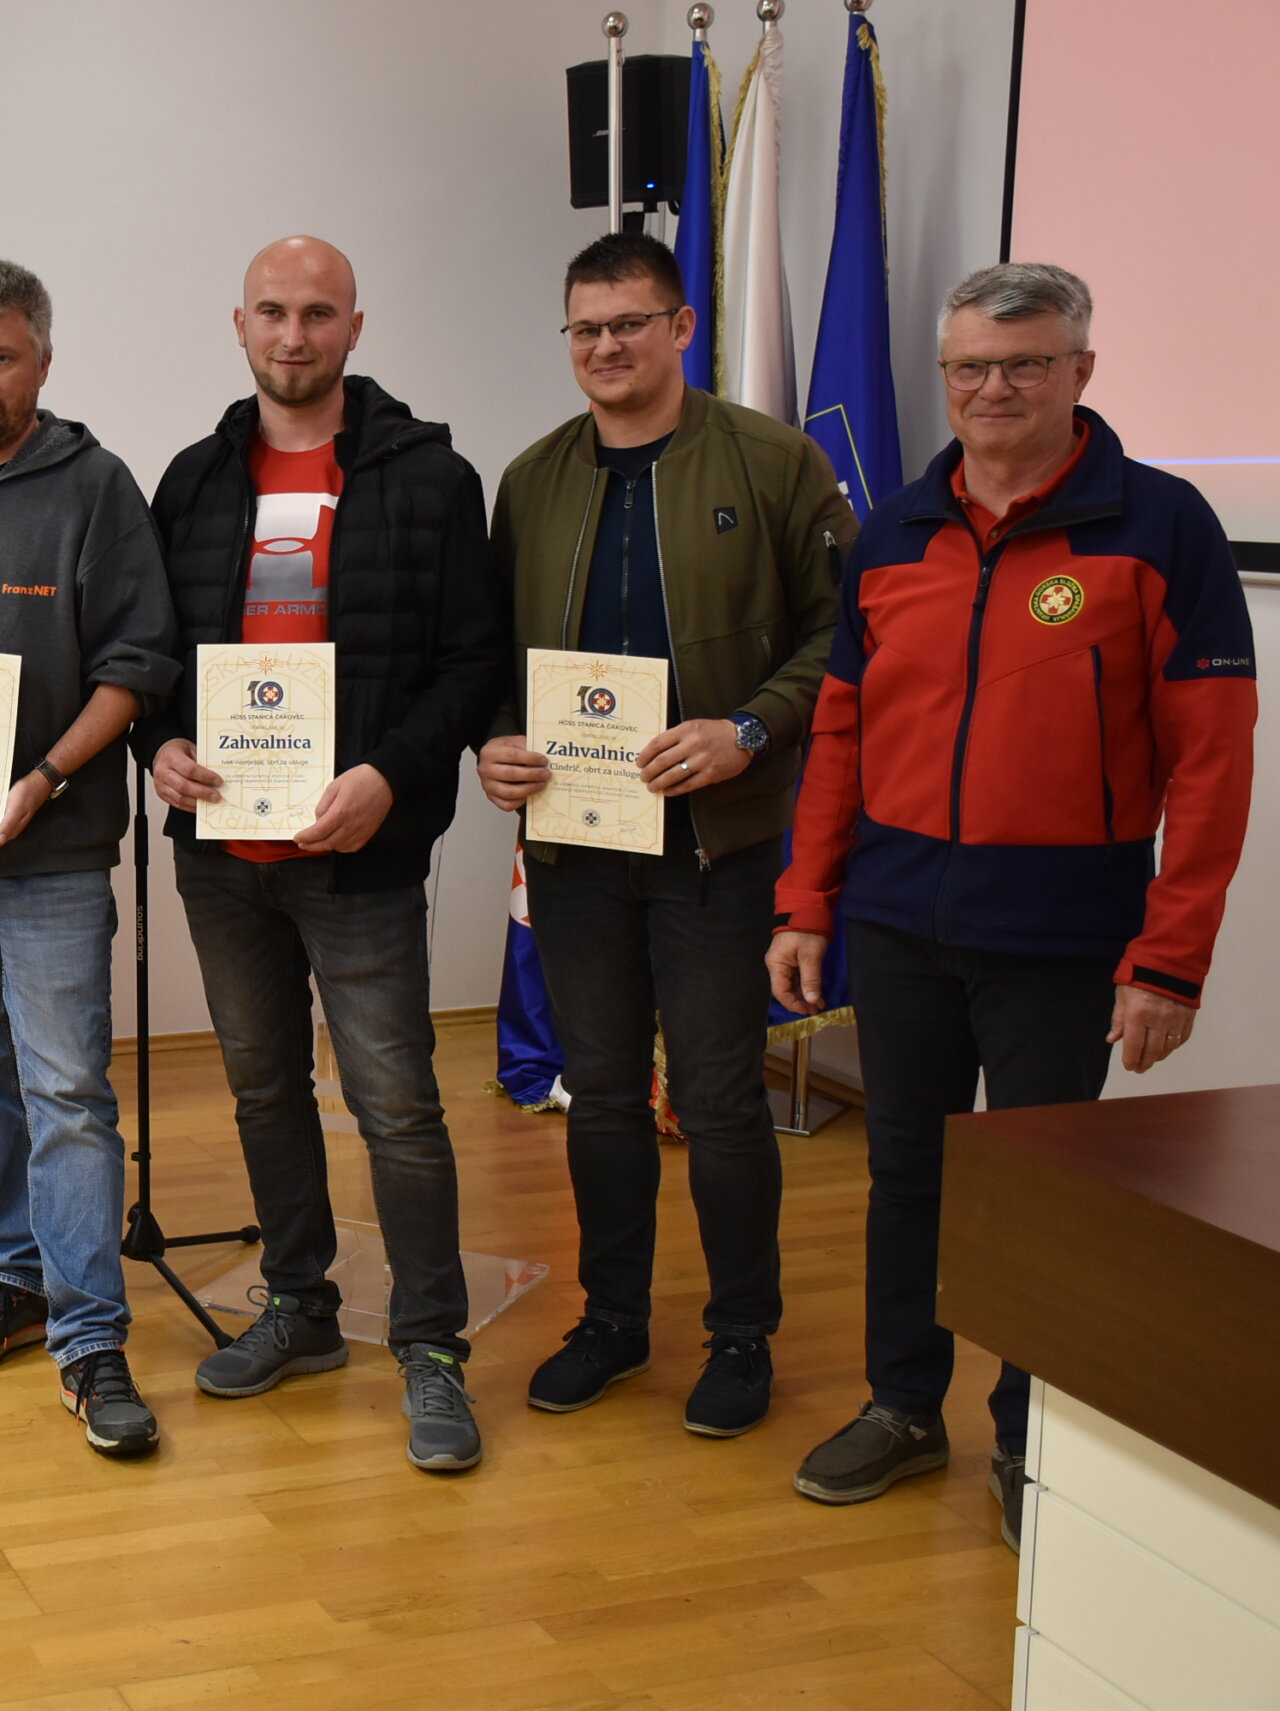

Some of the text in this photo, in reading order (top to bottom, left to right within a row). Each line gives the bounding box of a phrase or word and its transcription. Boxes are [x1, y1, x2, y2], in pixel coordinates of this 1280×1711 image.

[1, 583, 57, 597] FranzNET
[244, 603, 328, 616] ER ARMO
[577, 721, 605, 729] STANICA
[219, 734, 311, 750] Zahvalnica
[583, 765, 601, 774] obrt
